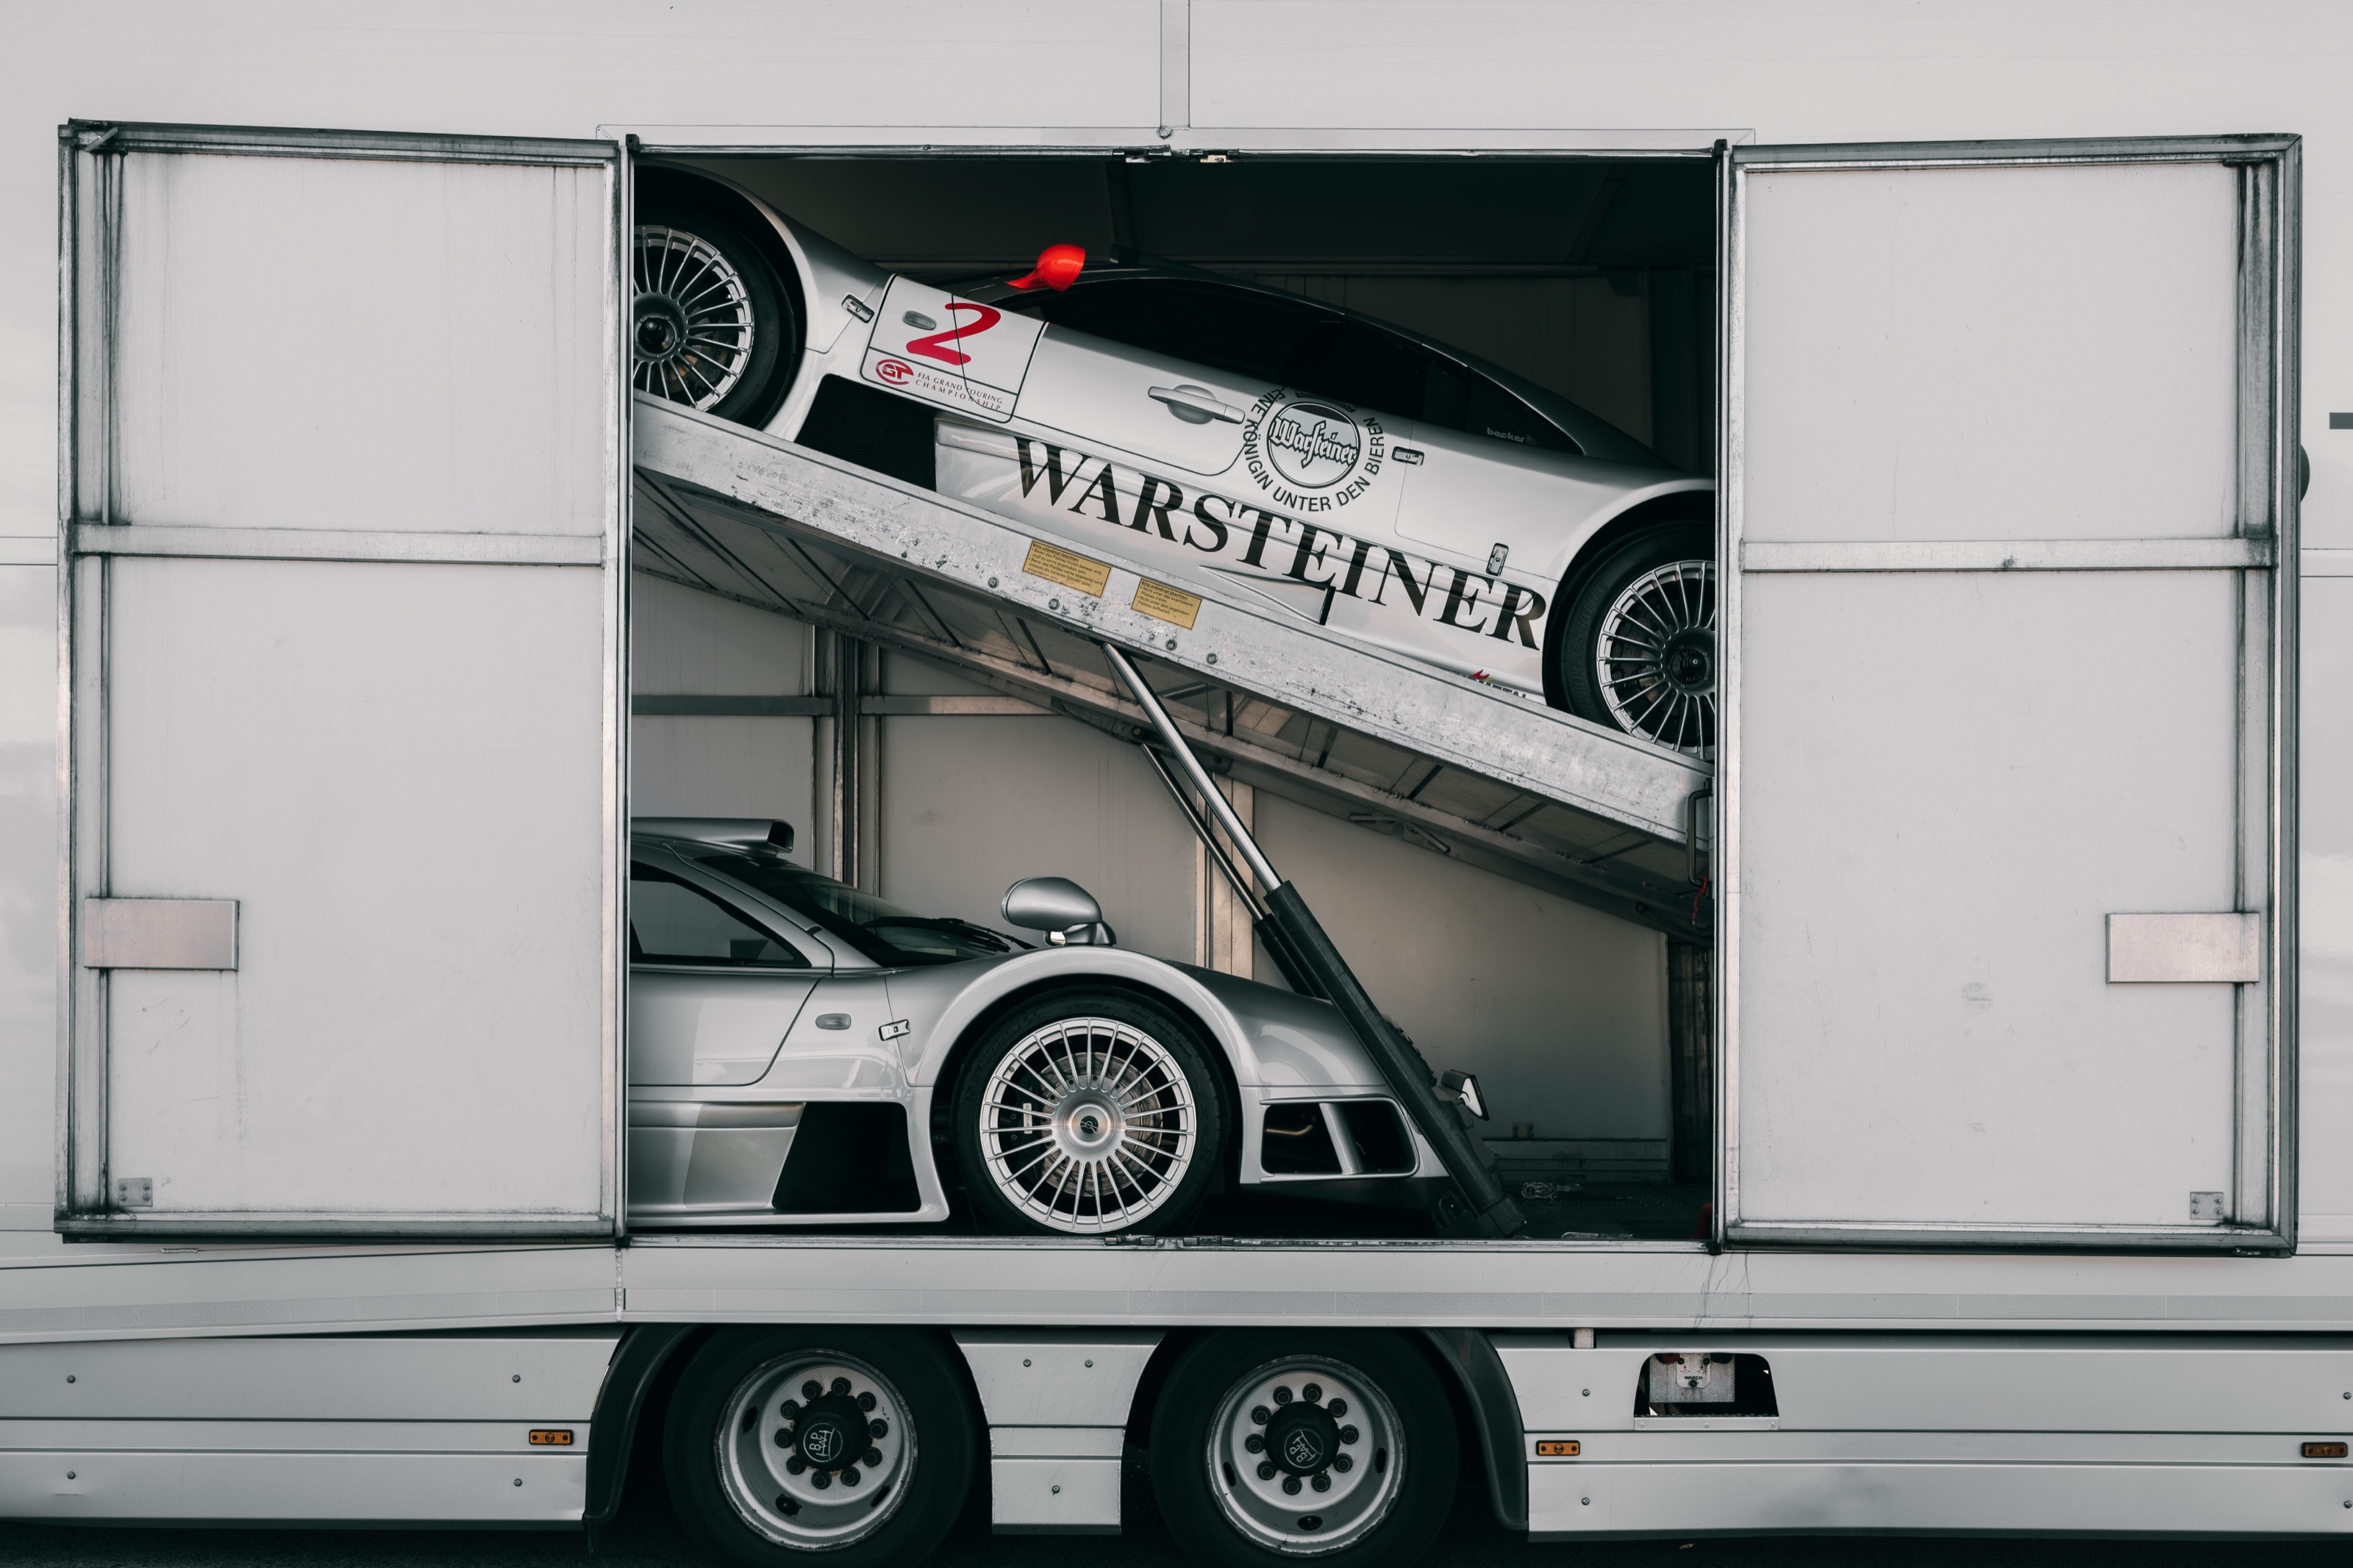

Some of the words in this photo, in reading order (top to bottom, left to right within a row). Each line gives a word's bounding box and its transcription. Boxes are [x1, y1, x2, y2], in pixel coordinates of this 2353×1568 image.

[906, 302, 1001, 366] 2
[915, 379, 1001, 411] CHAMPIONSHIP
[918, 372, 930, 382] FIA
[933, 377, 963, 391] GRAND
[1251, 389, 1286, 418] EINE
[1363, 416, 1385, 476] BIEREN
[1487, 427, 1525, 443] becker
[1243, 418, 1274, 491] KÖNIGIN
[1272, 486, 1332, 512] UNTER
[1335, 475, 1371, 506] DEN
[1013, 436, 1546, 651] WARSTEINER
[977, 1020, 1021, 1069] MICHELIN
